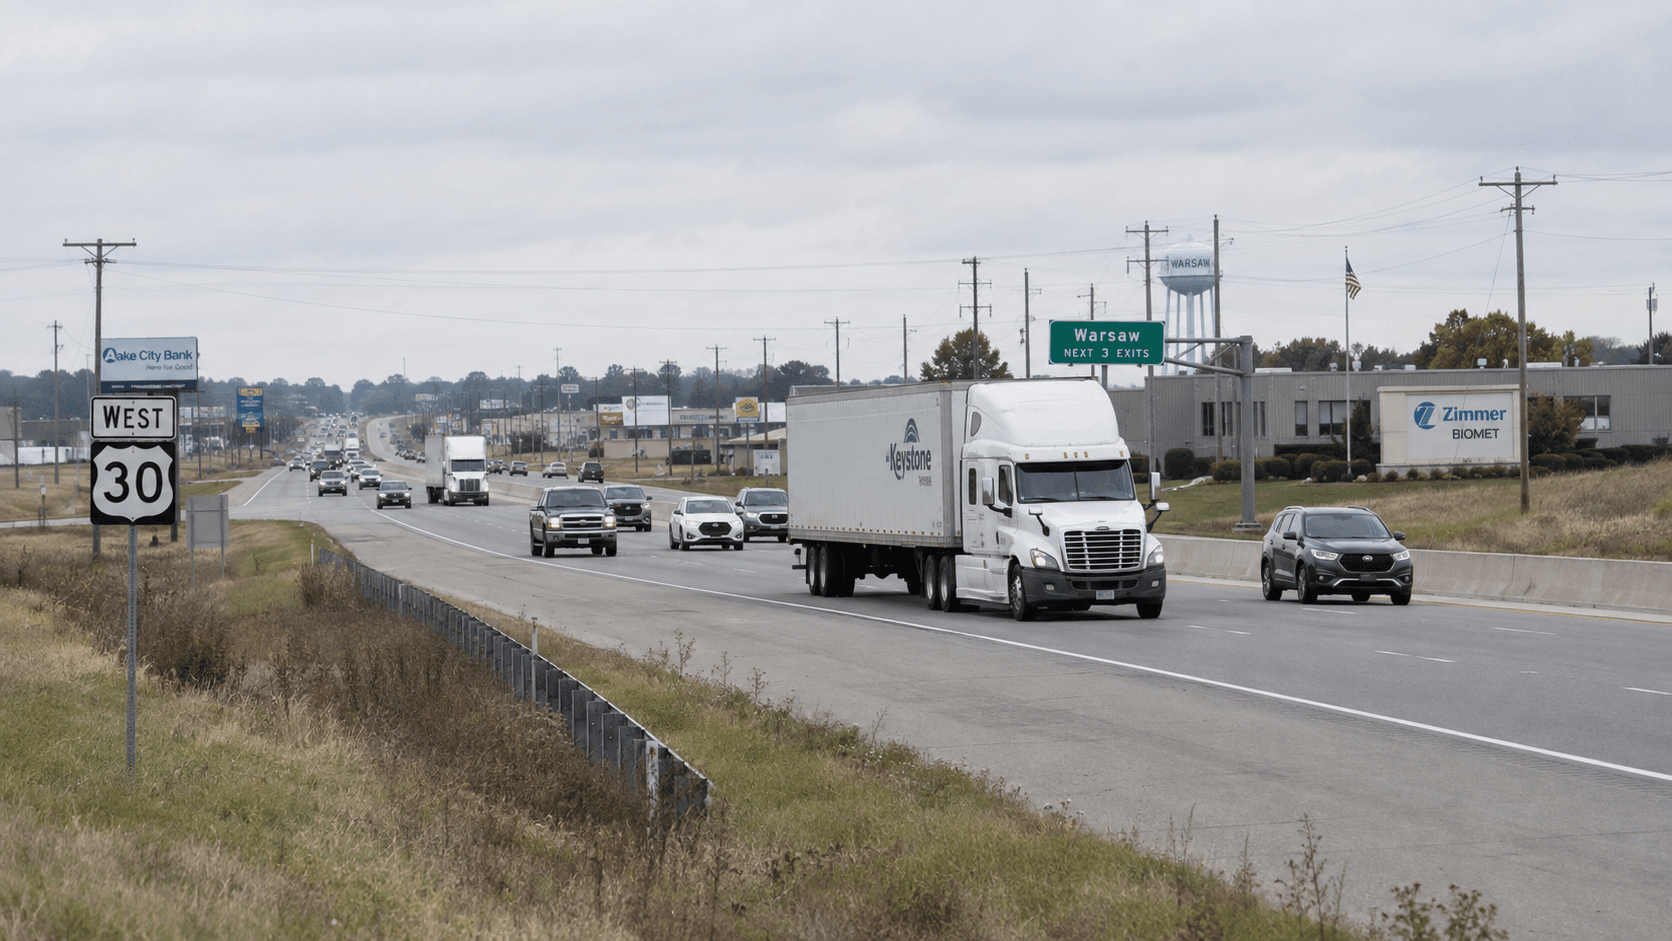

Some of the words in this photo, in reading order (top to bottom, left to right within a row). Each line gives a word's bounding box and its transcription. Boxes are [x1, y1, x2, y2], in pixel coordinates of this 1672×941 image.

[1171, 258, 1210, 268] WARSAW
[1074, 328, 1140, 342] Warsaw
[139, 350, 161, 362] City
[164, 350, 193, 360] Bank
[1064, 348, 1094, 358] NEXT
[1101, 347, 1109, 358] 3
[1116, 348, 1150, 358] EXITS
[163, 363, 173, 371] for
[174, 363, 193, 371] Good
[103, 405, 163, 429] WEST
[1442, 406, 1507, 422] Zimmer
[1452, 428, 1500, 440] BIOMET
[890, 442, 932, 481] Keystone
[103, 461, 163, 504] 30
